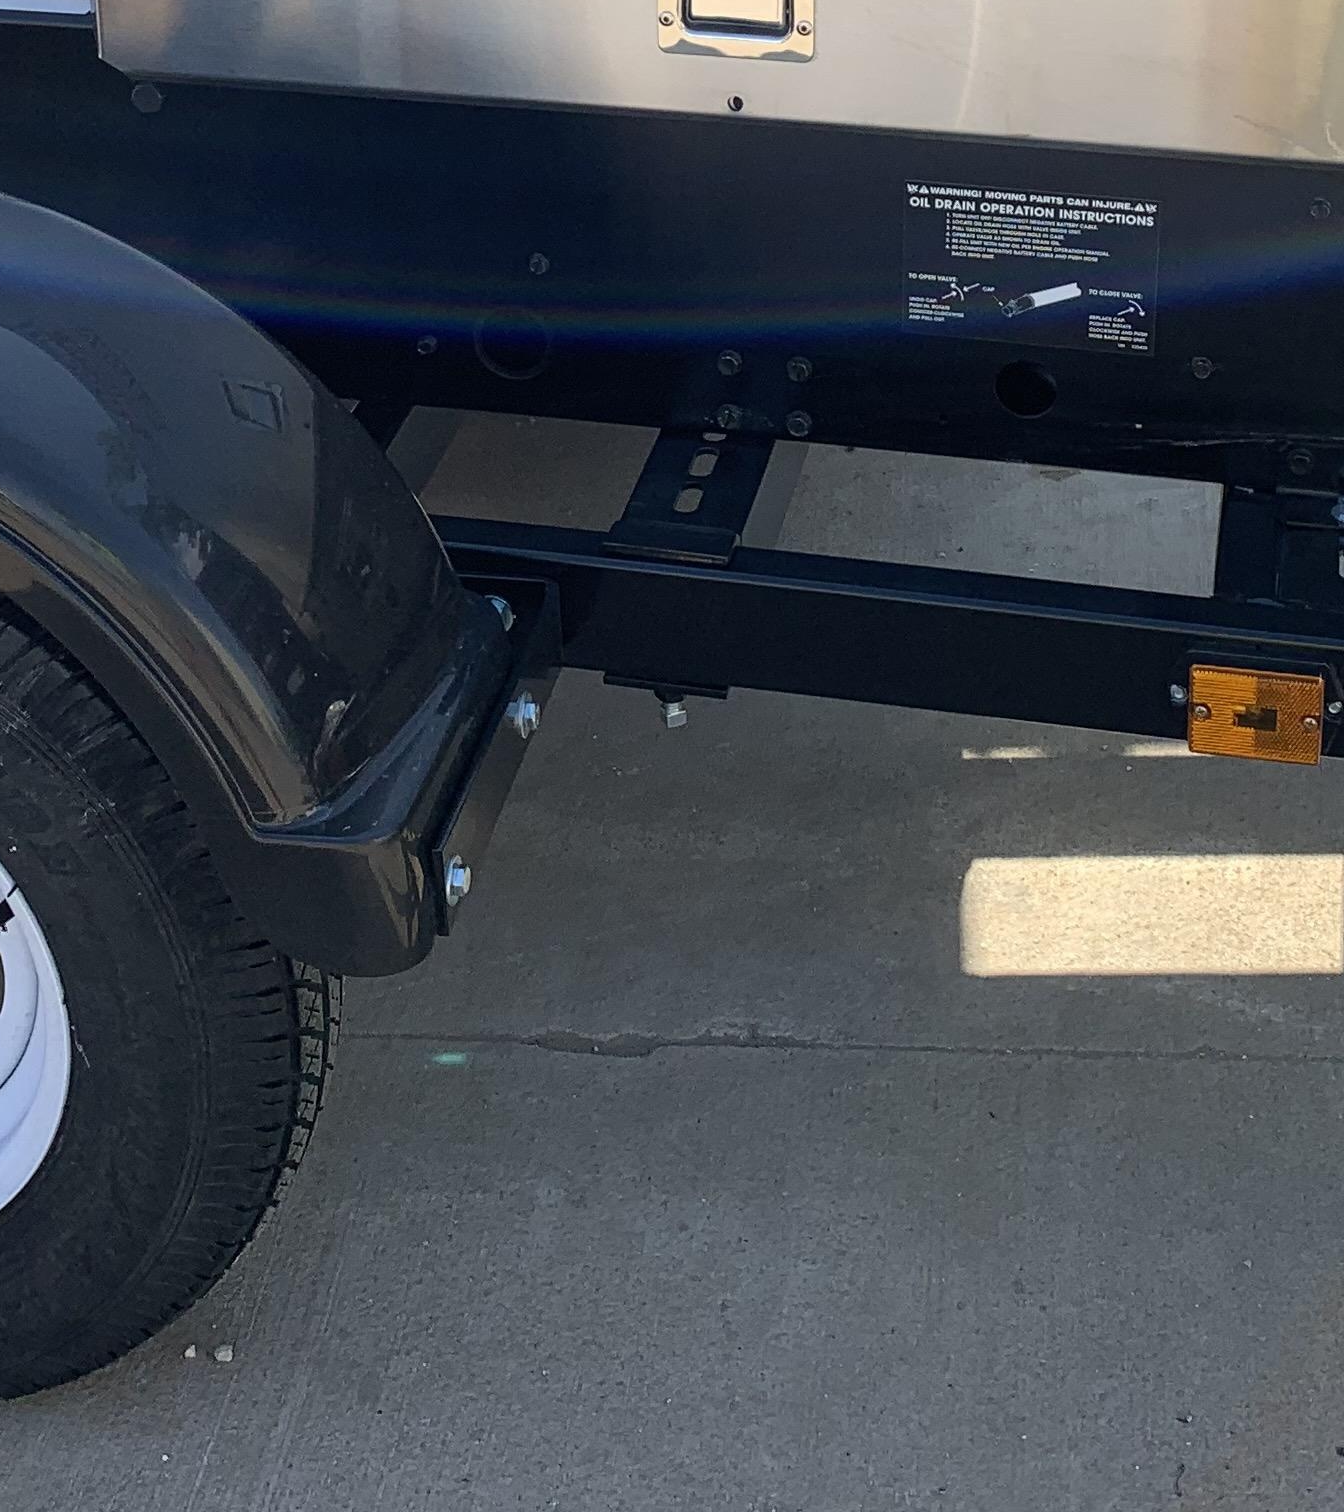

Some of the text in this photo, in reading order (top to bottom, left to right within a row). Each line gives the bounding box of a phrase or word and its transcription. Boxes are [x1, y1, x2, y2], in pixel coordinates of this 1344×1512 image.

[910, 195, 1155, 227] OIL DRAIN OPERATION INSTRUCTIONS
[929, 185, 1134, 210] WARNING! MOVING PARTS CAN INJURE.
